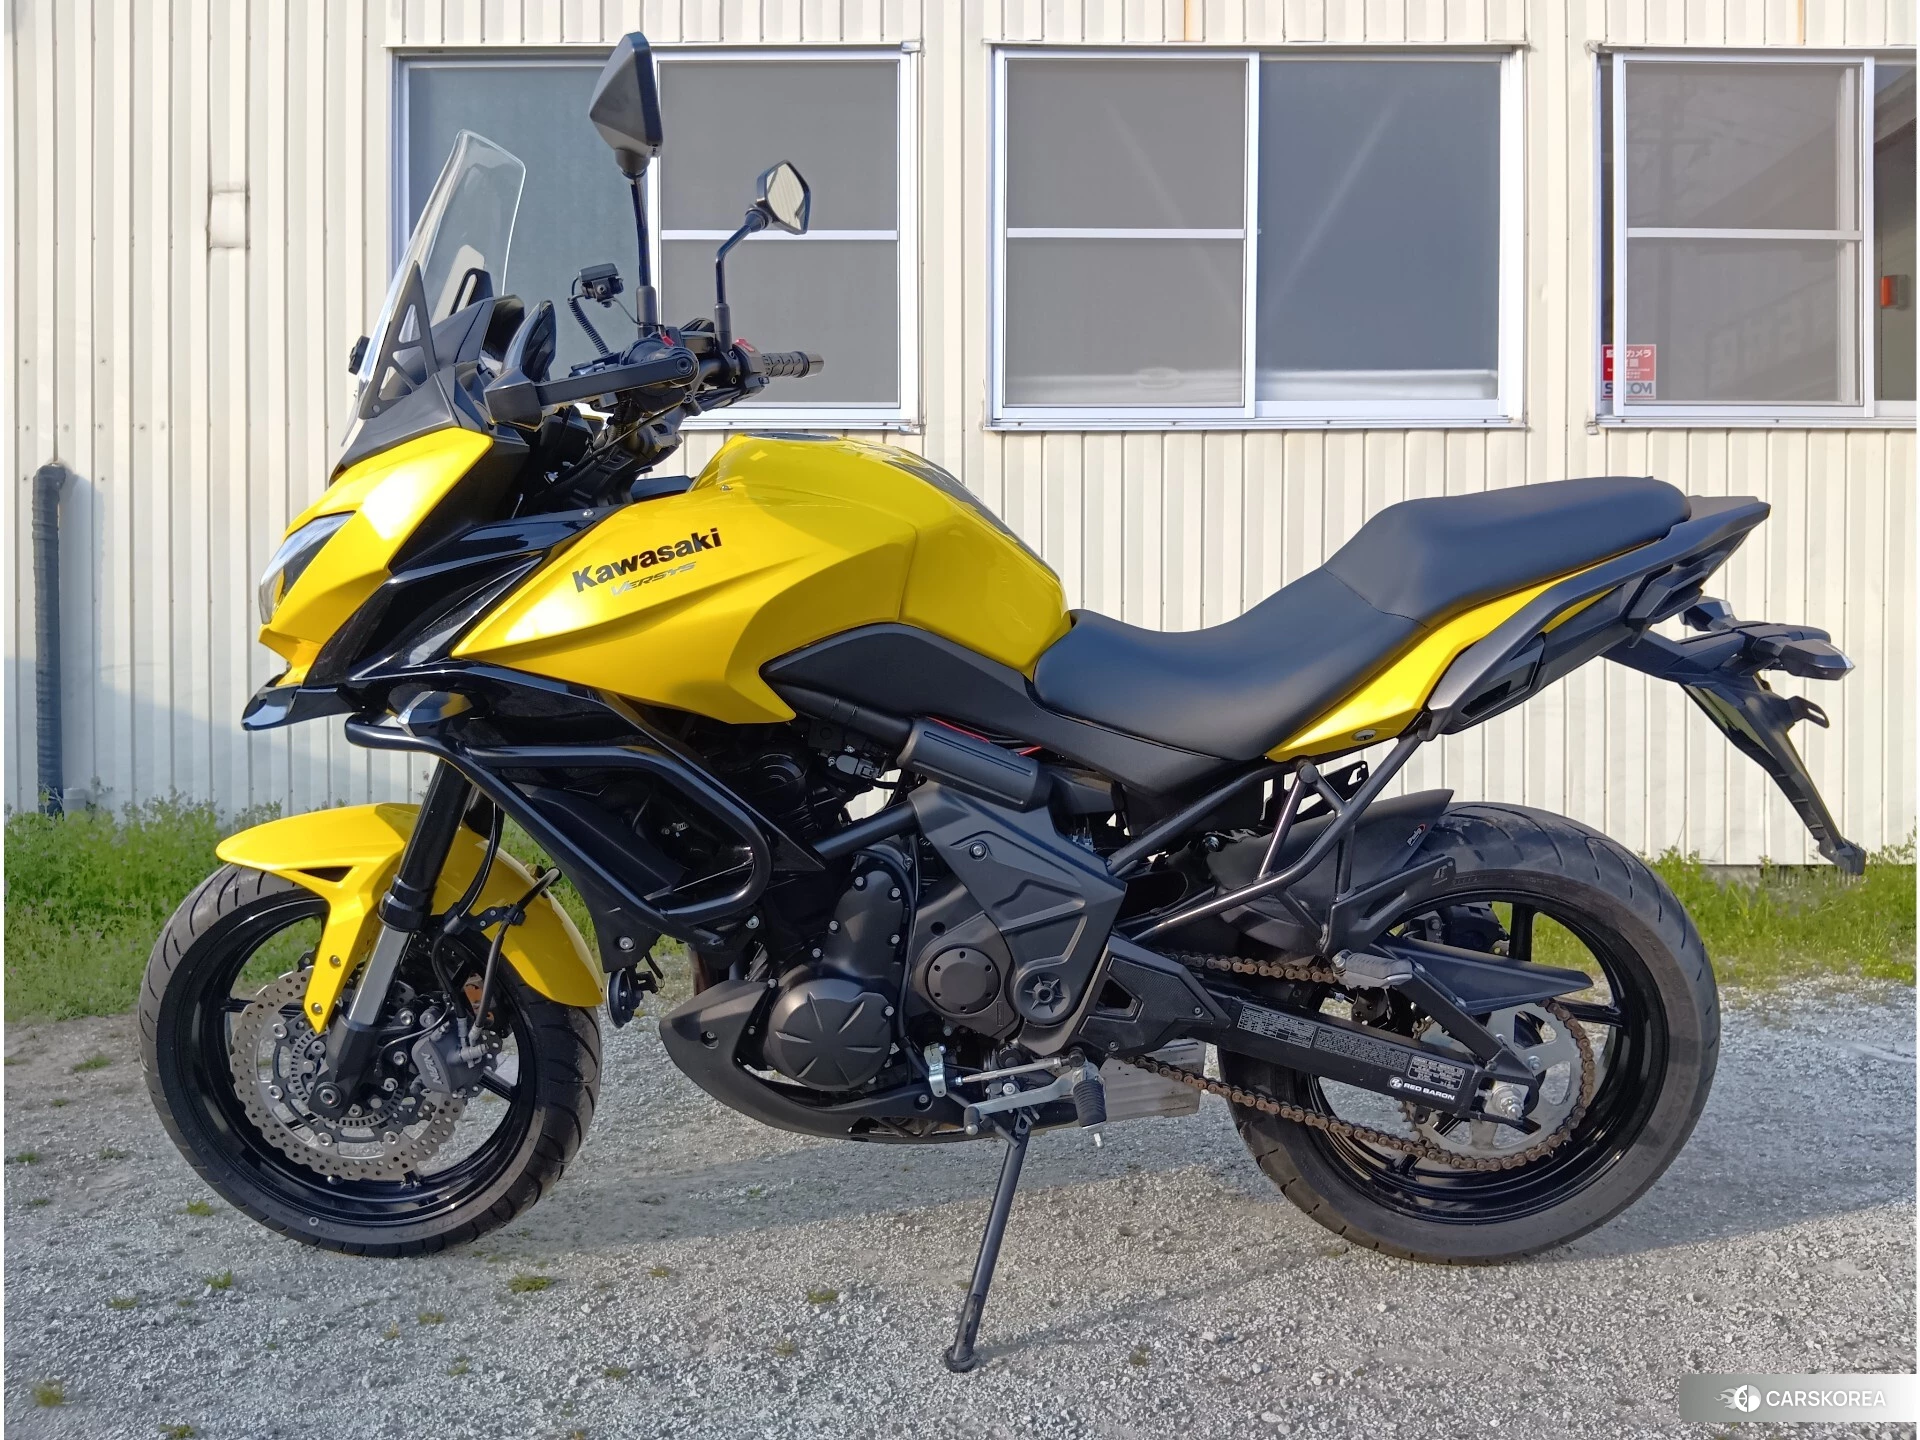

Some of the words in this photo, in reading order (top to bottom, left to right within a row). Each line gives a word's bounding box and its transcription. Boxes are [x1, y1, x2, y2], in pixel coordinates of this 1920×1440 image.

[1605, 382, 1652, 394] SOM
[572, 527, 722, 593] Kawasaki
[611, 561, 697, 596] VERSYS
[1403, 1082, 1422, 1092] RED
[1422, 1087, 1456, 1100] BARON
